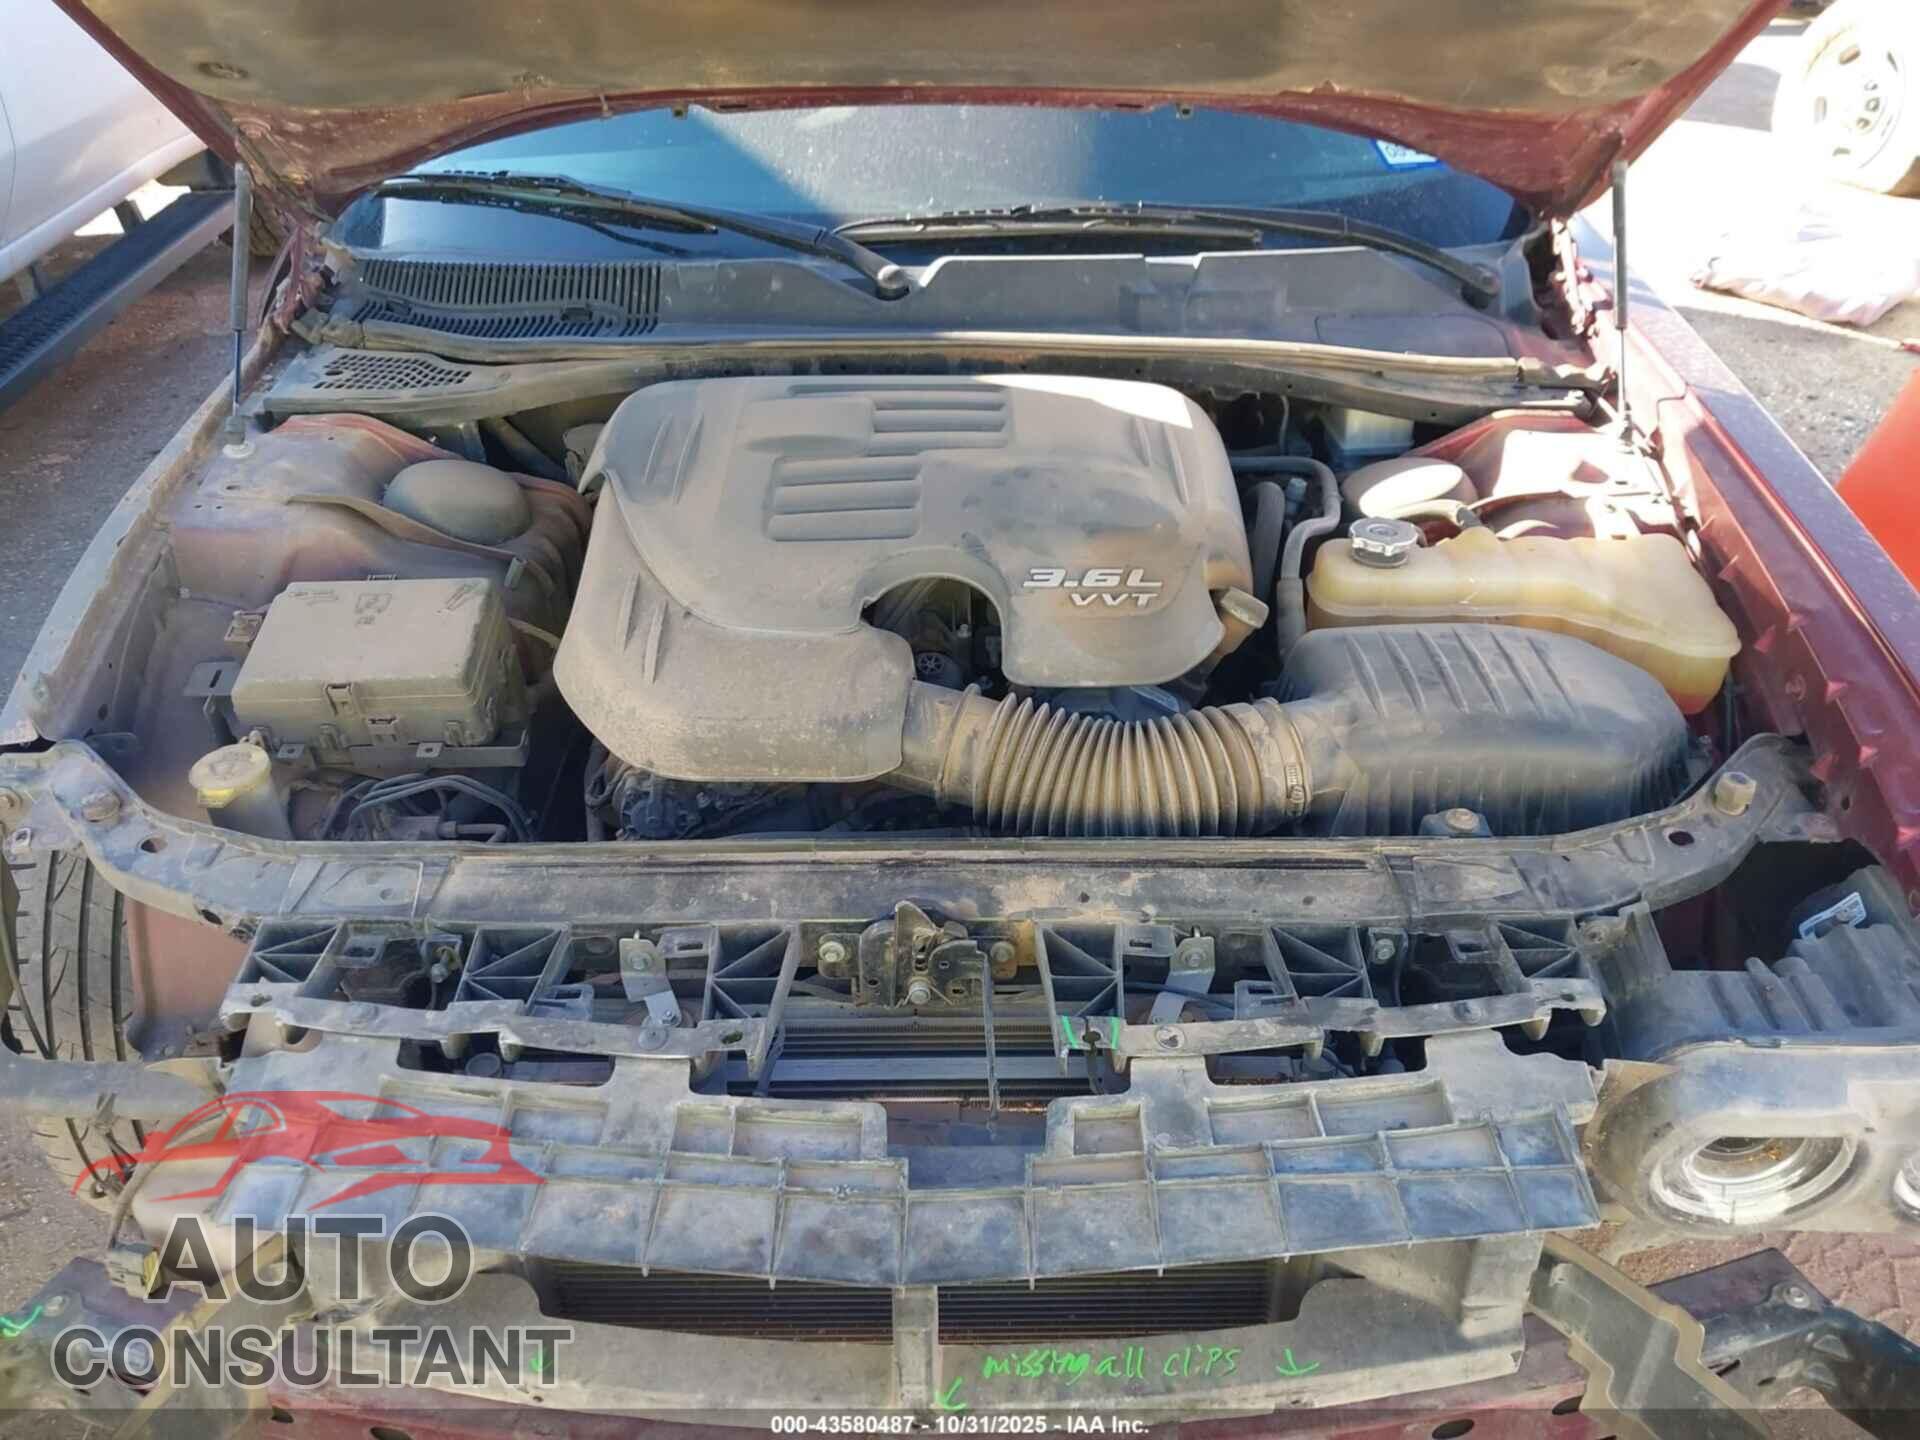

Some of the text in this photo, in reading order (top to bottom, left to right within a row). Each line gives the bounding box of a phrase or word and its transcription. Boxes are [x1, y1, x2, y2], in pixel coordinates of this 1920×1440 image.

[1023, 568, 1164, 588] 3.6L
[1070, 593, 1159, 606] VVT
[983, 1349, 1091, 1386] missing
[1095, 1346, 1145, 1378] all
